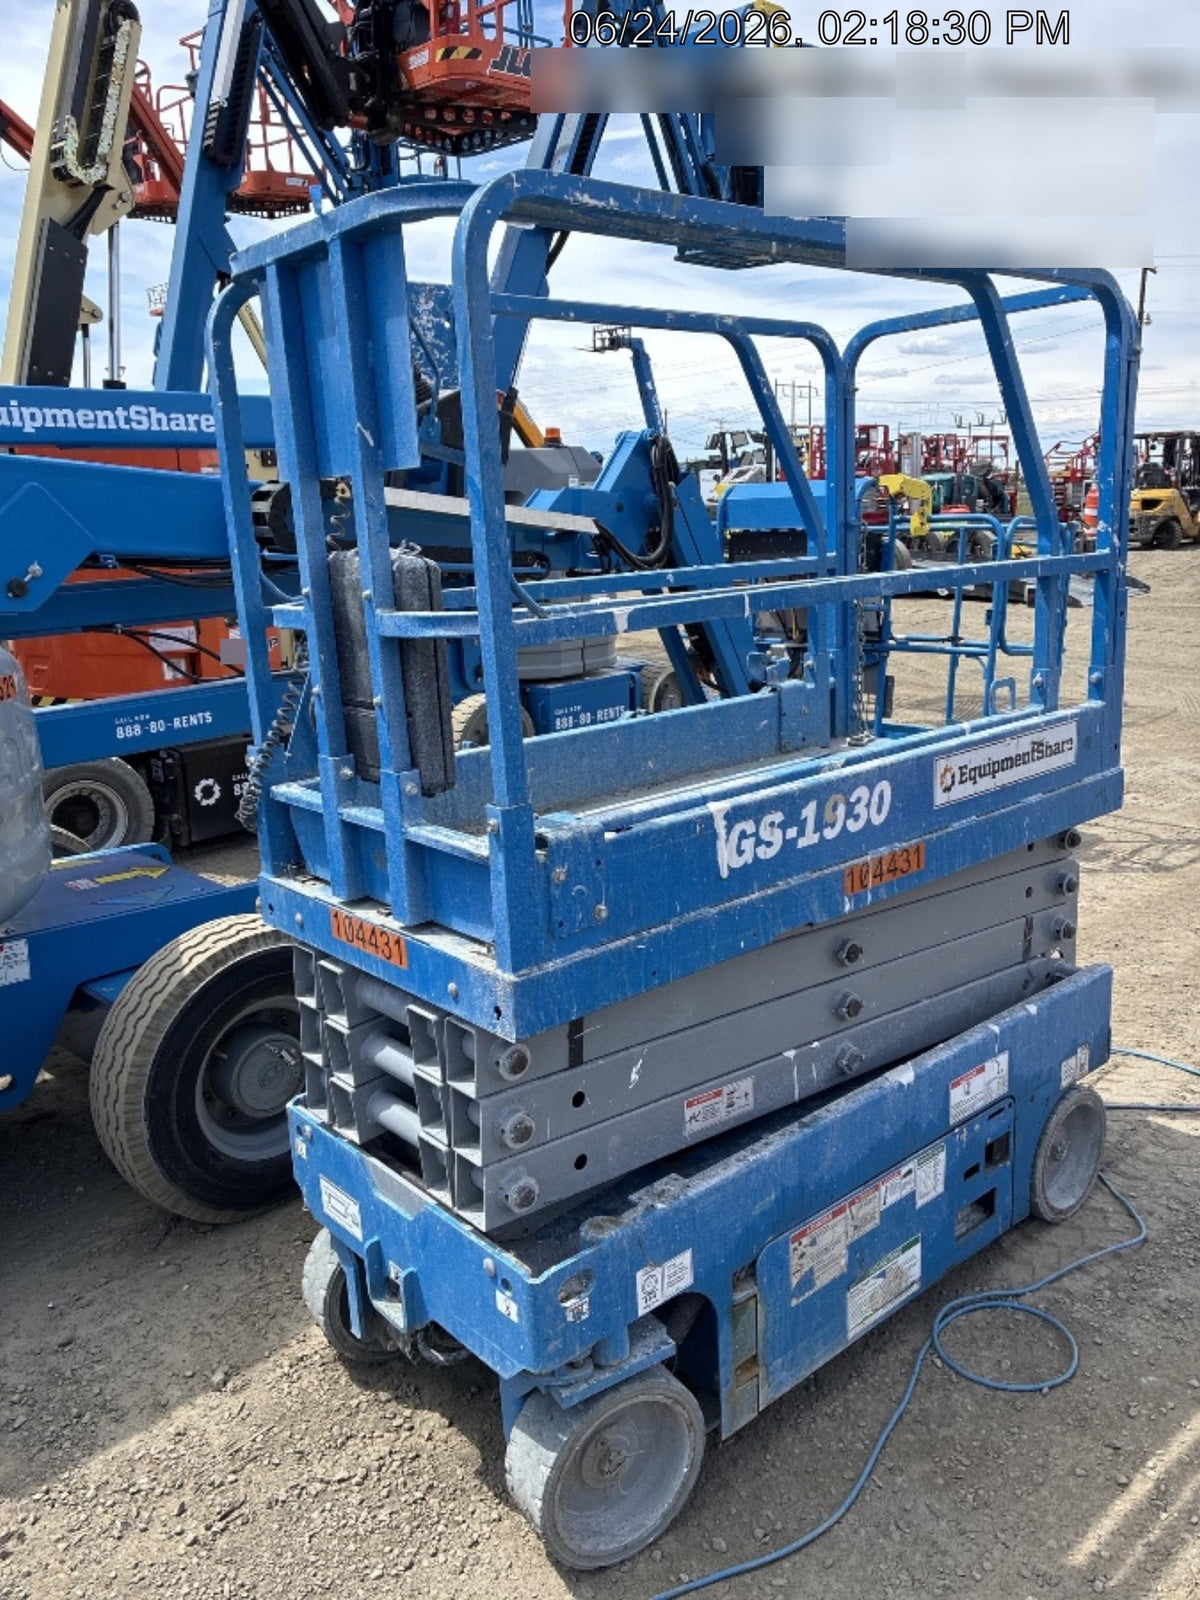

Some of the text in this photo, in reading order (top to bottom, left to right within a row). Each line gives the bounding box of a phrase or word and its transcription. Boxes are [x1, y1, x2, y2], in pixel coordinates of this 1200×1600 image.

[116, 711, 213, 739] 888-80-RENTS
[727, 779, 892, 869] GS-1930
[847, 845, 920, 893] 104431
[331, 910, 403, 966] 104431
